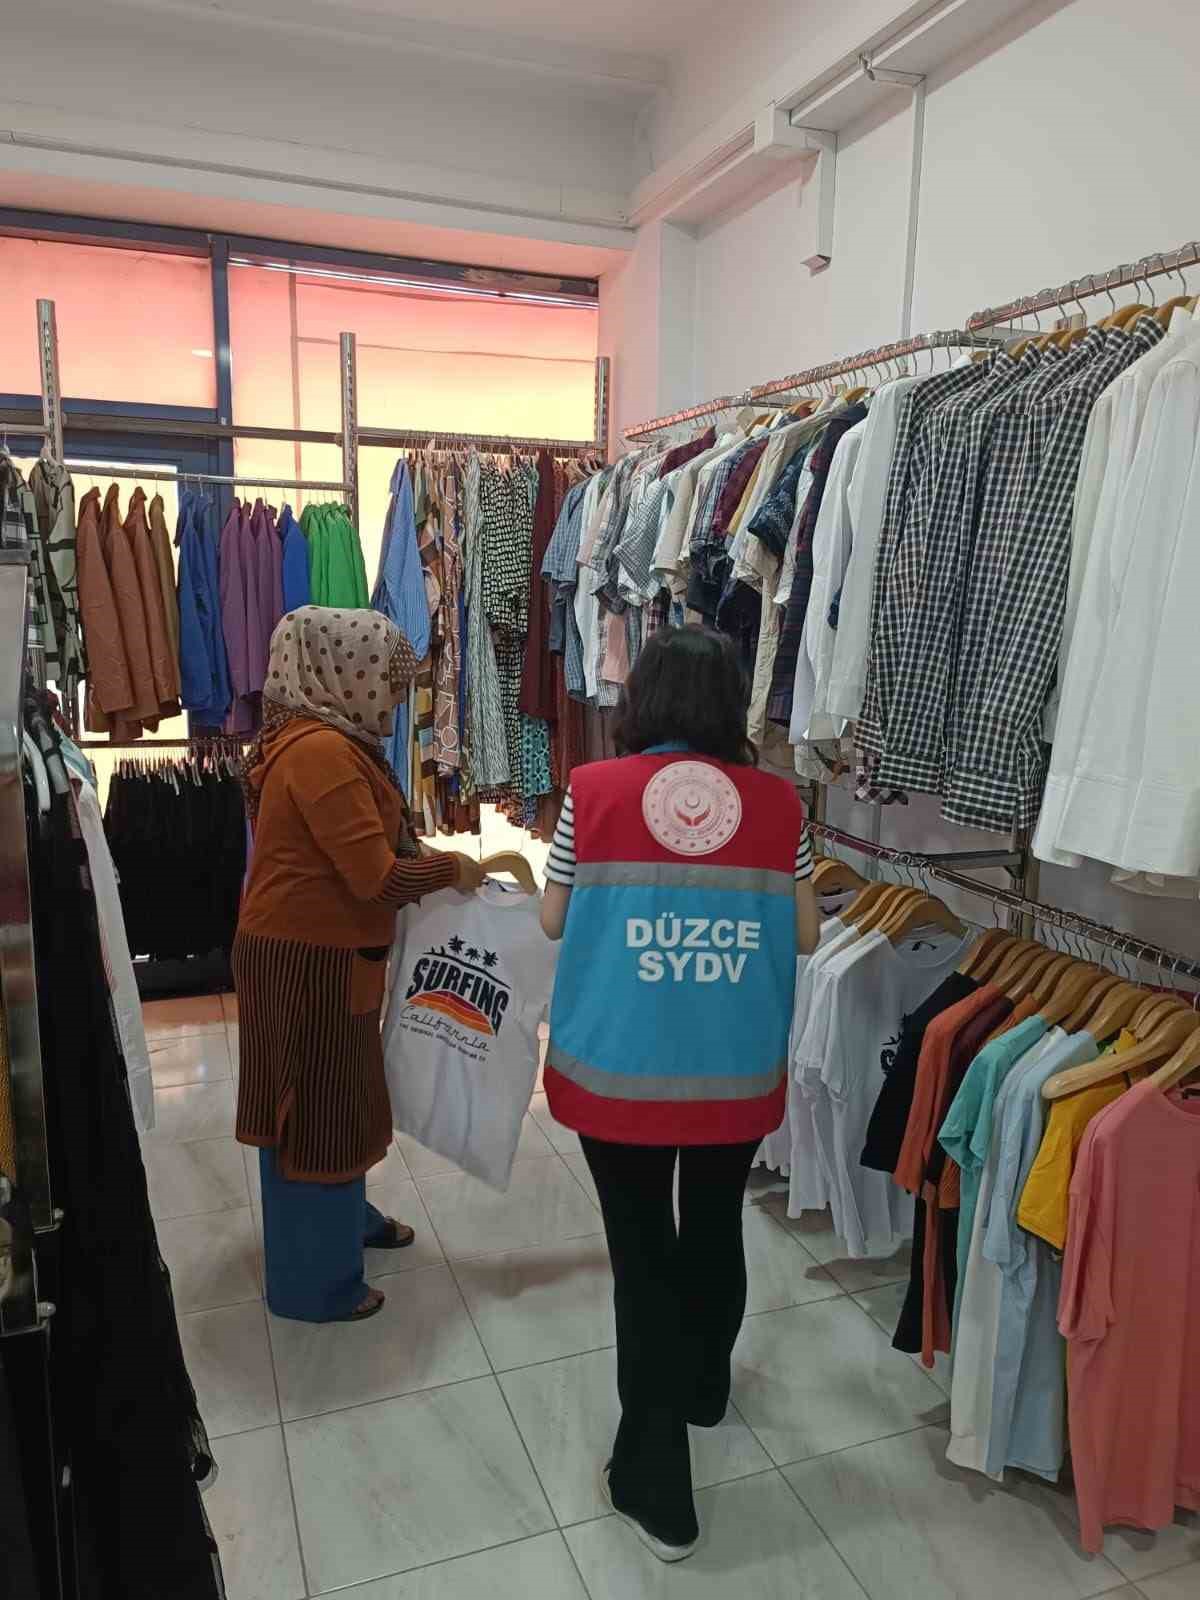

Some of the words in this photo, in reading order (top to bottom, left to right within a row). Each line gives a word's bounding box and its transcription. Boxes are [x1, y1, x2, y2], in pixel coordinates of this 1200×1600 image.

[626, 912, 761, 949] DÜZCE
[637, 950, 747, 984] SYDV
[405, 957, 509, 1038] SURFING
